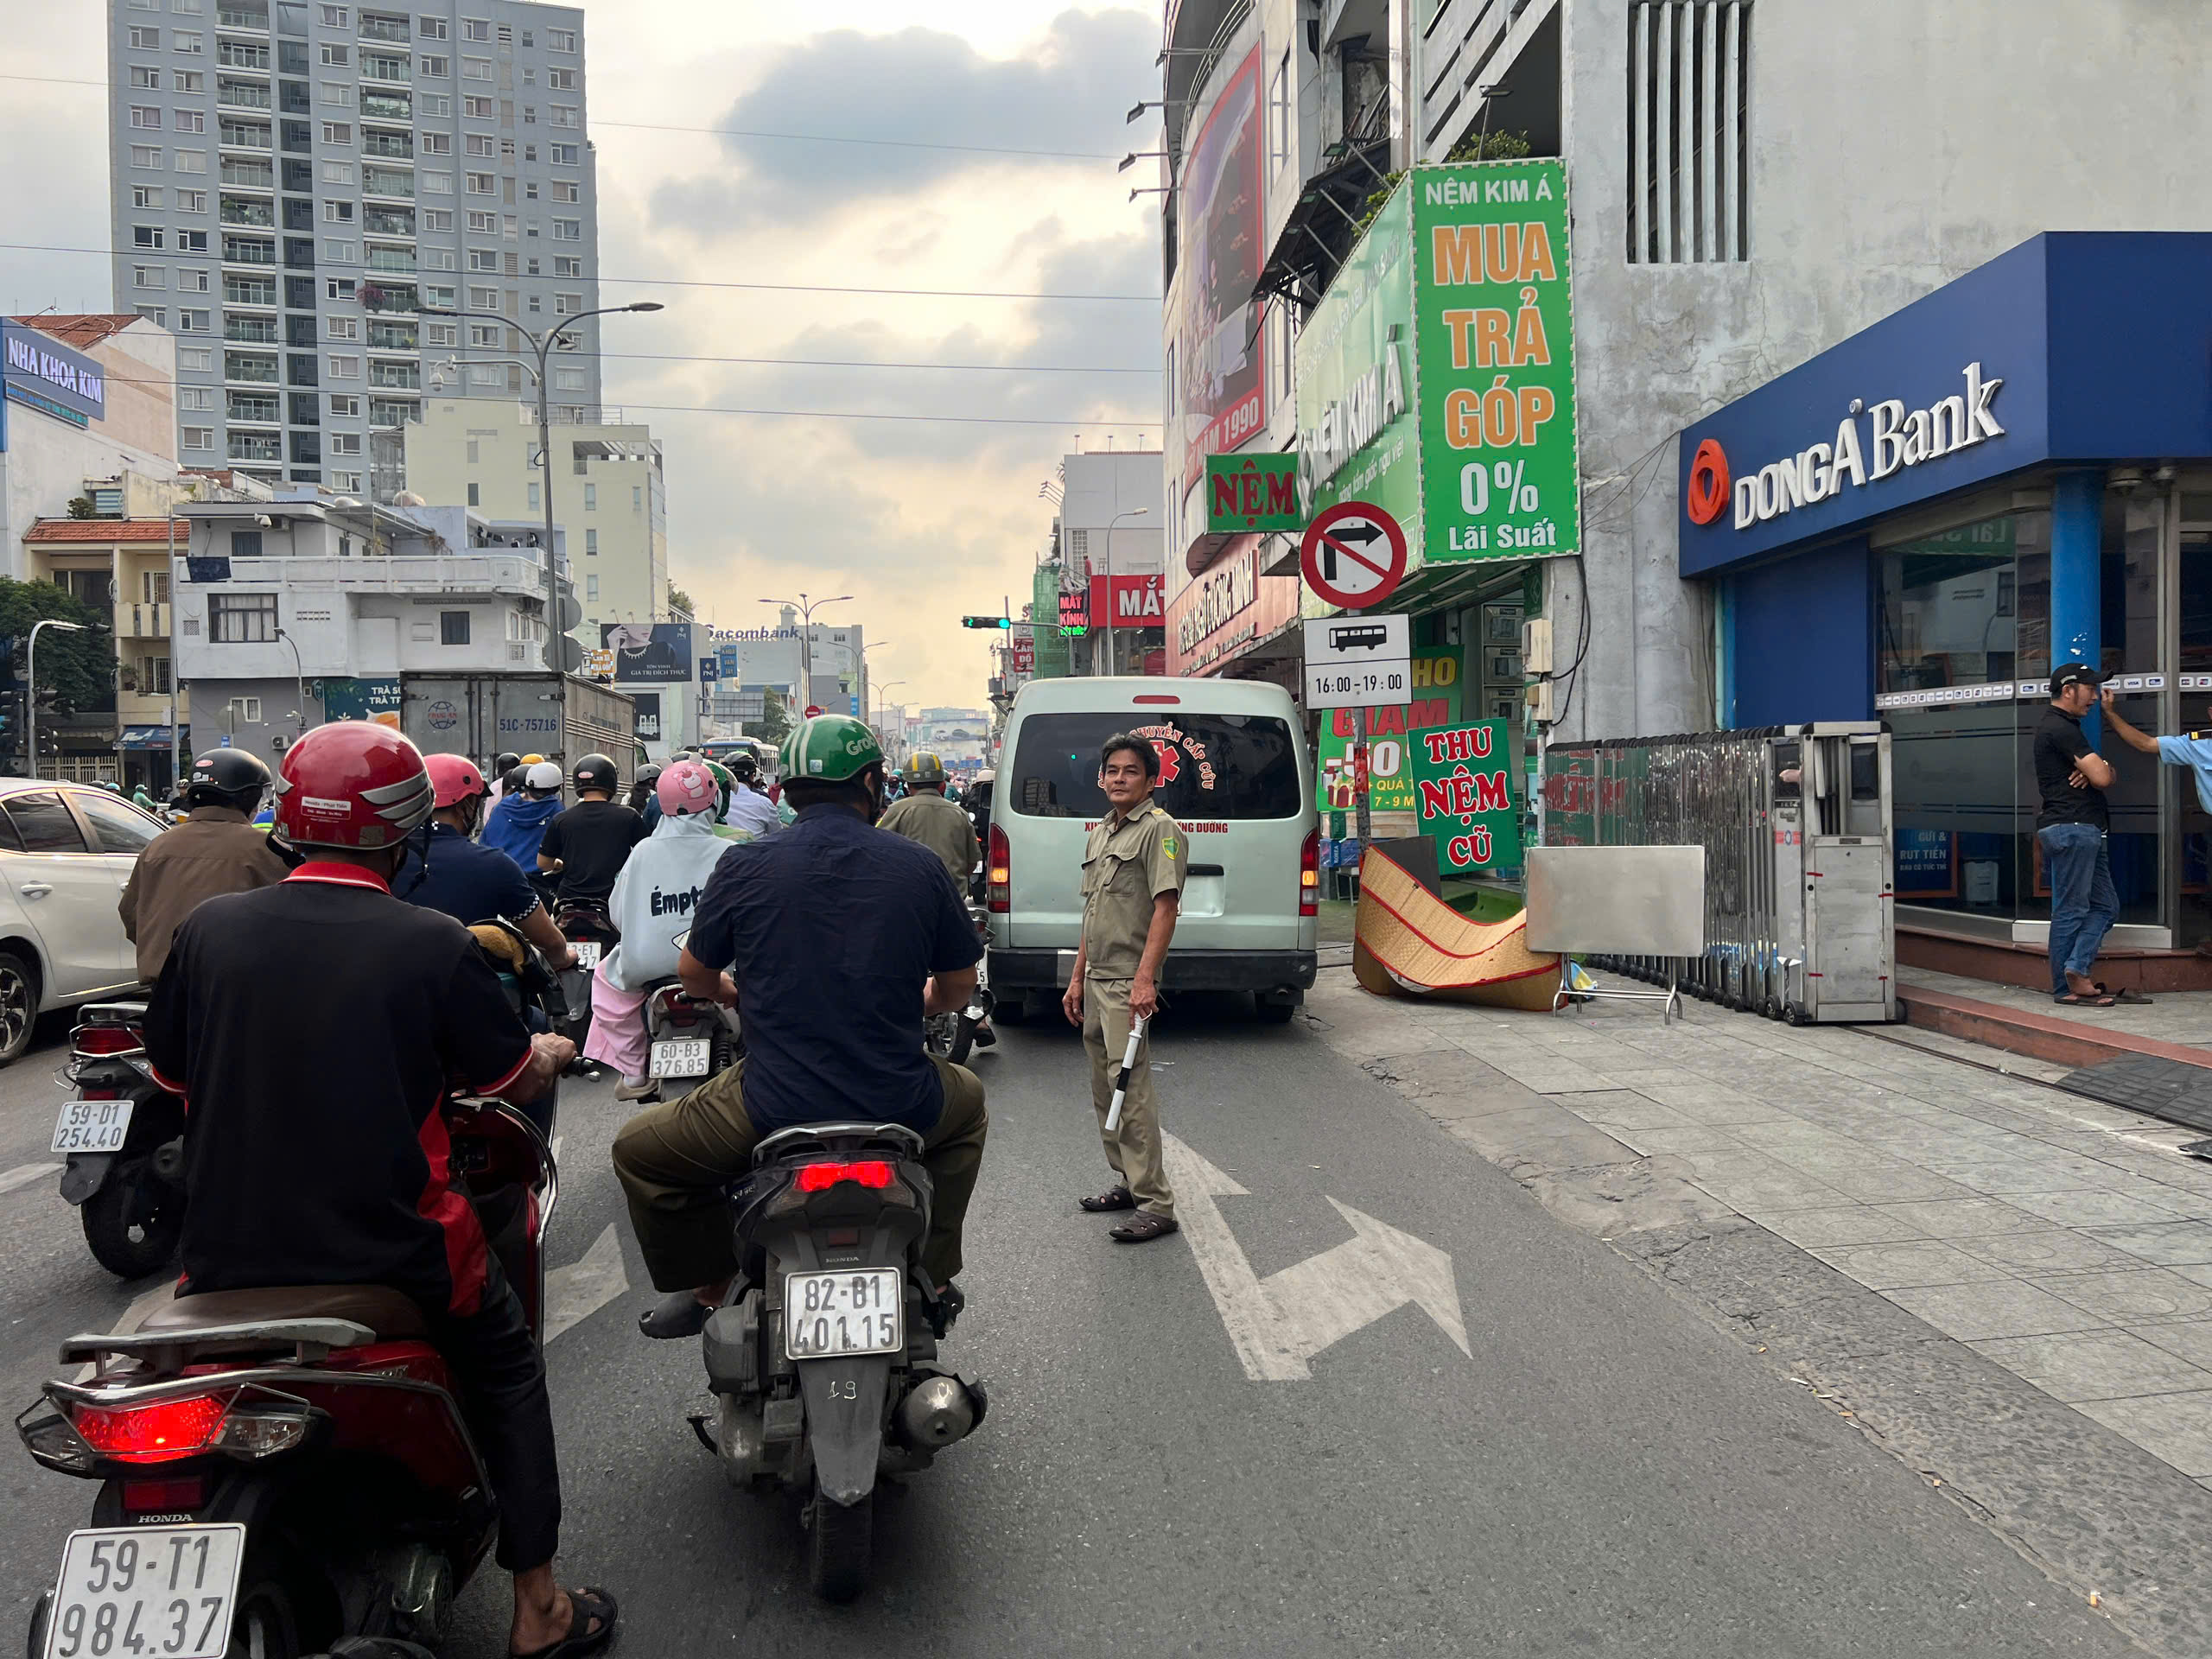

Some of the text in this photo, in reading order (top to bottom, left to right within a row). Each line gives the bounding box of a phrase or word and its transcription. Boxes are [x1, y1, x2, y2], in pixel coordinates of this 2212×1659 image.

[1426, 173, 1553, 209] NỆM KIM Á
[1432, 221, 1557, 286] MUA
[1442, 286, 1551, 370] TRẢ
[8, 338, 102, 403] NHA KHOA KIM
[1224, 397, 1259, 444] 1990
[1445, 375, 1555, 449] GÓP
[1868, 362, 2006, 481] Bank
[1212, 459, 1295, 526] NỆM
[1459, 460, 1540, 516] 0%
[1448, 524, 1488, 552] Lãi
[1497, 518, 1557, 549] Suất
[371, 685, 391, 695] TRÀ
[1412, 657, 1457, 688] HO
[369, 695, 388, 704] TRÀ
[846, 733, 876, 756] Grab
[1183, 737, 1206, 760] CẤP
[1424, 726, 1493, 764] THU
[1199, 761, 1217, 790] CỨU
[1376, 777, 1404, 791] QUÀ
[1418, 764, 1510, 826] NỆM
[1196, 821, 1229, 833] ĐƯỜNG
[1447, 824, 1493, 867] CŨ
[655, 1058, 705, 1075] 376.85
[661, 1043, 700, 1059] 60-B3
[69, 1105, 120, 1125] 59-D1
[56, 1127, 122, 1147] 254.40
[804, 1275, 880, 1312] 82-B1
[794, 1313, 894, 1351] 401.15
[138, 1514, 193, 1523] HONDA
[86, 1535, 211, 1593] 59-T1
[58, 1597, 224, 1657] 984.37
